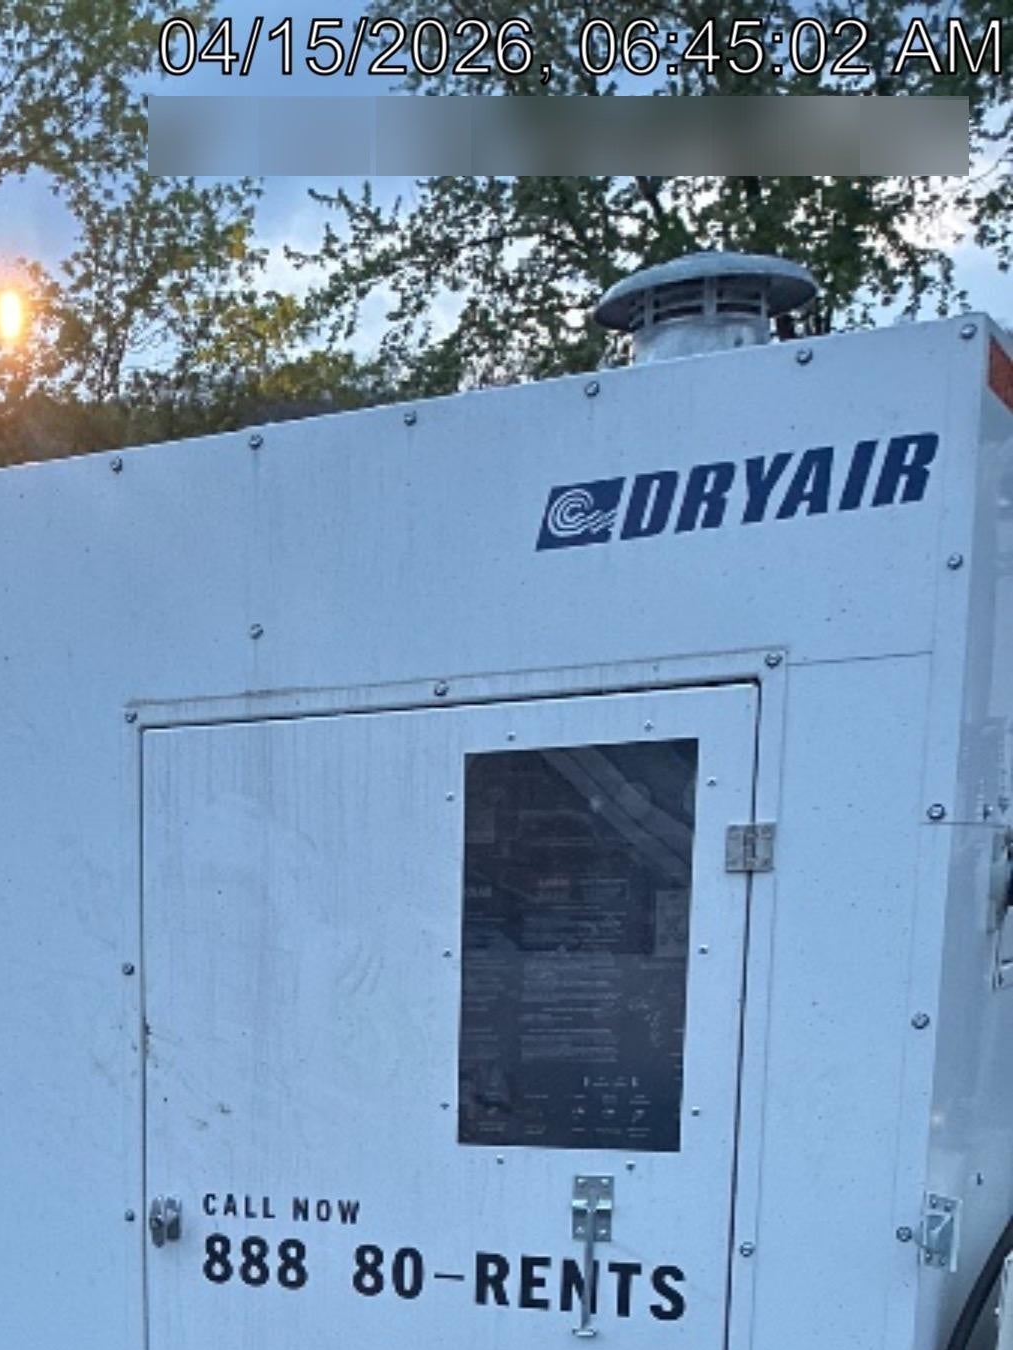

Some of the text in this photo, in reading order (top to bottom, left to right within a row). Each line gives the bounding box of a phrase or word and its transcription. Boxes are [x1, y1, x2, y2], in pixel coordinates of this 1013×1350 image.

[619, 432, 940, 541] DRYAIR
[202, 1193, 360, 1225] CALL NOW
[202, 1232, 308, 1290] 888
